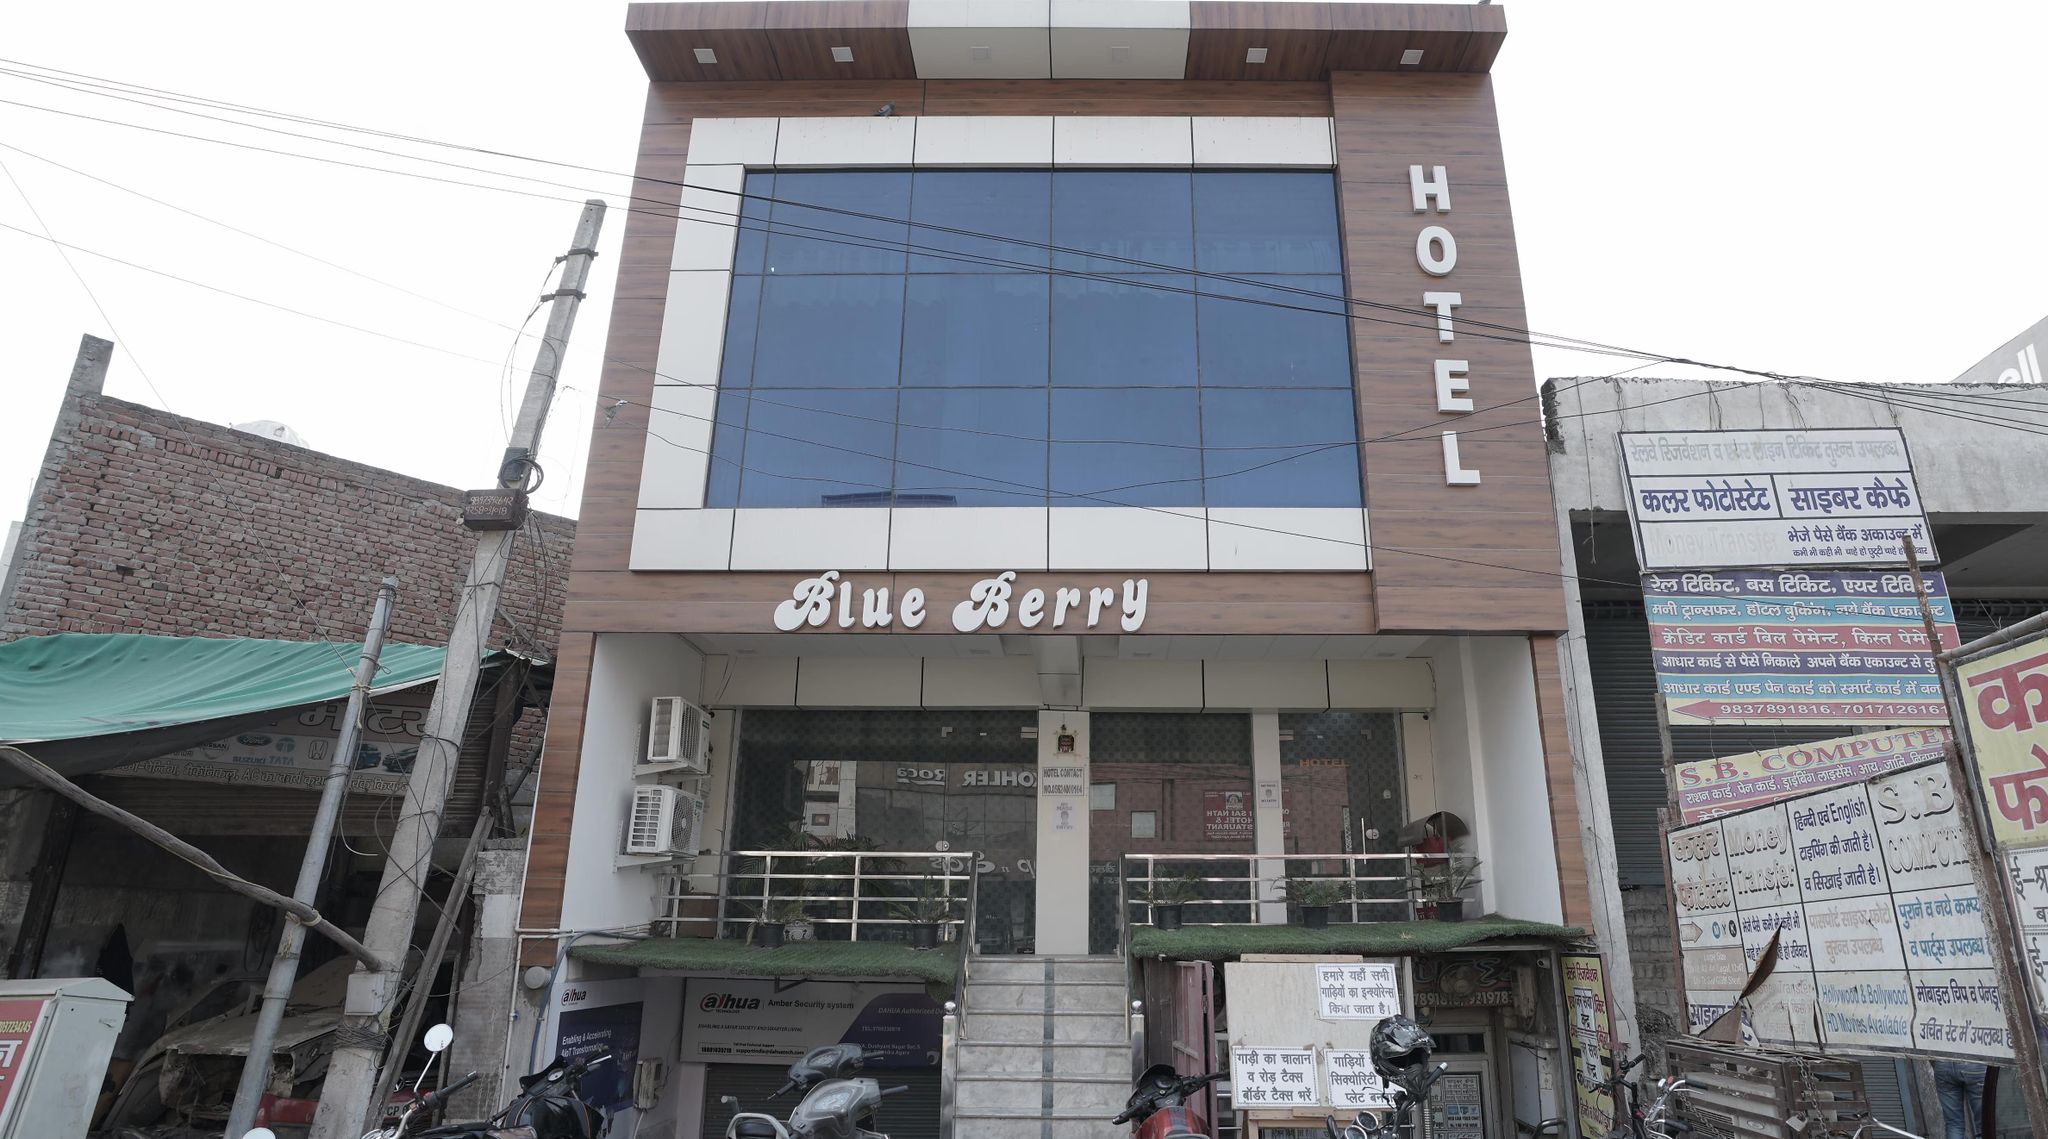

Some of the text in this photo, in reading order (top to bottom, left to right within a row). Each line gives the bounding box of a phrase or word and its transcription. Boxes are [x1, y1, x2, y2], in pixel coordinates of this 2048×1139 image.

[1408, 164, 1481, 486] HOTEL
[1640, 478, 1771, 513] कलर फोटोस्टेट
[1787, 476, 1911, 513] साइबर कैफे
[1788, 525, 1811, 542] भेजे
[1813, 524, 1833, 542] पैसे
[1836, 524, 1857, 542] बैंक
[1911, 523, 1923, 540] में
[1650, 573, 1878, 594] रेल टिकिट, बस टिकिट, एयर
[773, 570, 1149, 632] Blue Berry
[1652, 600, 1678, 616] मनी
[1745, 602, 1781, 616] होटल
[1862, 601, 1886, 616] बैंक
[1662, 627, 1706, 645] क्रेडिट
[1711, 626, 1748, 645] कार्ड
[1753, 626, 1787, 645] बिल
[1851, 627, 1892, 645] किस्त
[1662, 652, 1922, 668] आधार कार्ड से पैसे निकाले अपने बैंक एकाउन्ट से
[1663, 679, 1918, 695] आधार कार्ड एण्ड पेन कार्ड को स्मार्ट कार्ड में
[1720, 704, 1836, 716] 9837891816,
[1680, 761, 1749, 786] S.B.
[1686, 792, 1711, 804] राशन
[1738, 779, 1754, 795] पेन
[1793, 796, 1868, 831] हिन्दी एवं English
[1799, 837, 1829, 862] टाइपिंग
[1829, 834, 1841, 855] की
[1841, 830, 1862, 853] जाती
[1804, 877, 1812, 891] व
[1812, 866, 1843, 891] सिखाई
[1843, 863, 1867, 887] जाती
[1898, 893, 1952, 930] पुराने व नये
[1909, 940, 1919, 958] व
[1947, 936, 1985, 957] उपलब्ध
[1322, 966, 1390, 982] हमारे यहाँ सभी
[1320, 983, 1346, 1000] गाड़ियों
[1348, 987, 1359, 998] का
[1821, 984, 1860, 1008] Hollywood
[1867, 983, 1909, 1010] Bollywood
[1915, 978, 1978, 1006] मोबाइल चिप व
[768, 999, 854, 1009] Amber Security system
[1353, 1004, 1375, 1015] जाता
[1824, 1012, 1839, 1033] HD
[1840, 1012, 1868, 1035] Movies
[1868, 1013, 1908, 1037] Available
[1920, 1016, 2004, 1047] उचित रेट में उपलब्ध
[1236, 1050, 1312, 1066] गाड़ी का चालान
[1333, 1053, 1365, 1070] गाड़ियों
[1247, 1067, 1304, 1085] व रोड़ टैक्स
[1329, 1071, 1377, 1086] सिक्योरिटी
[1242, 1085, 1312, 1103] बॉर्डर टैक्स भरें
[1345, 1088, 1365, 1104] प्लेट
